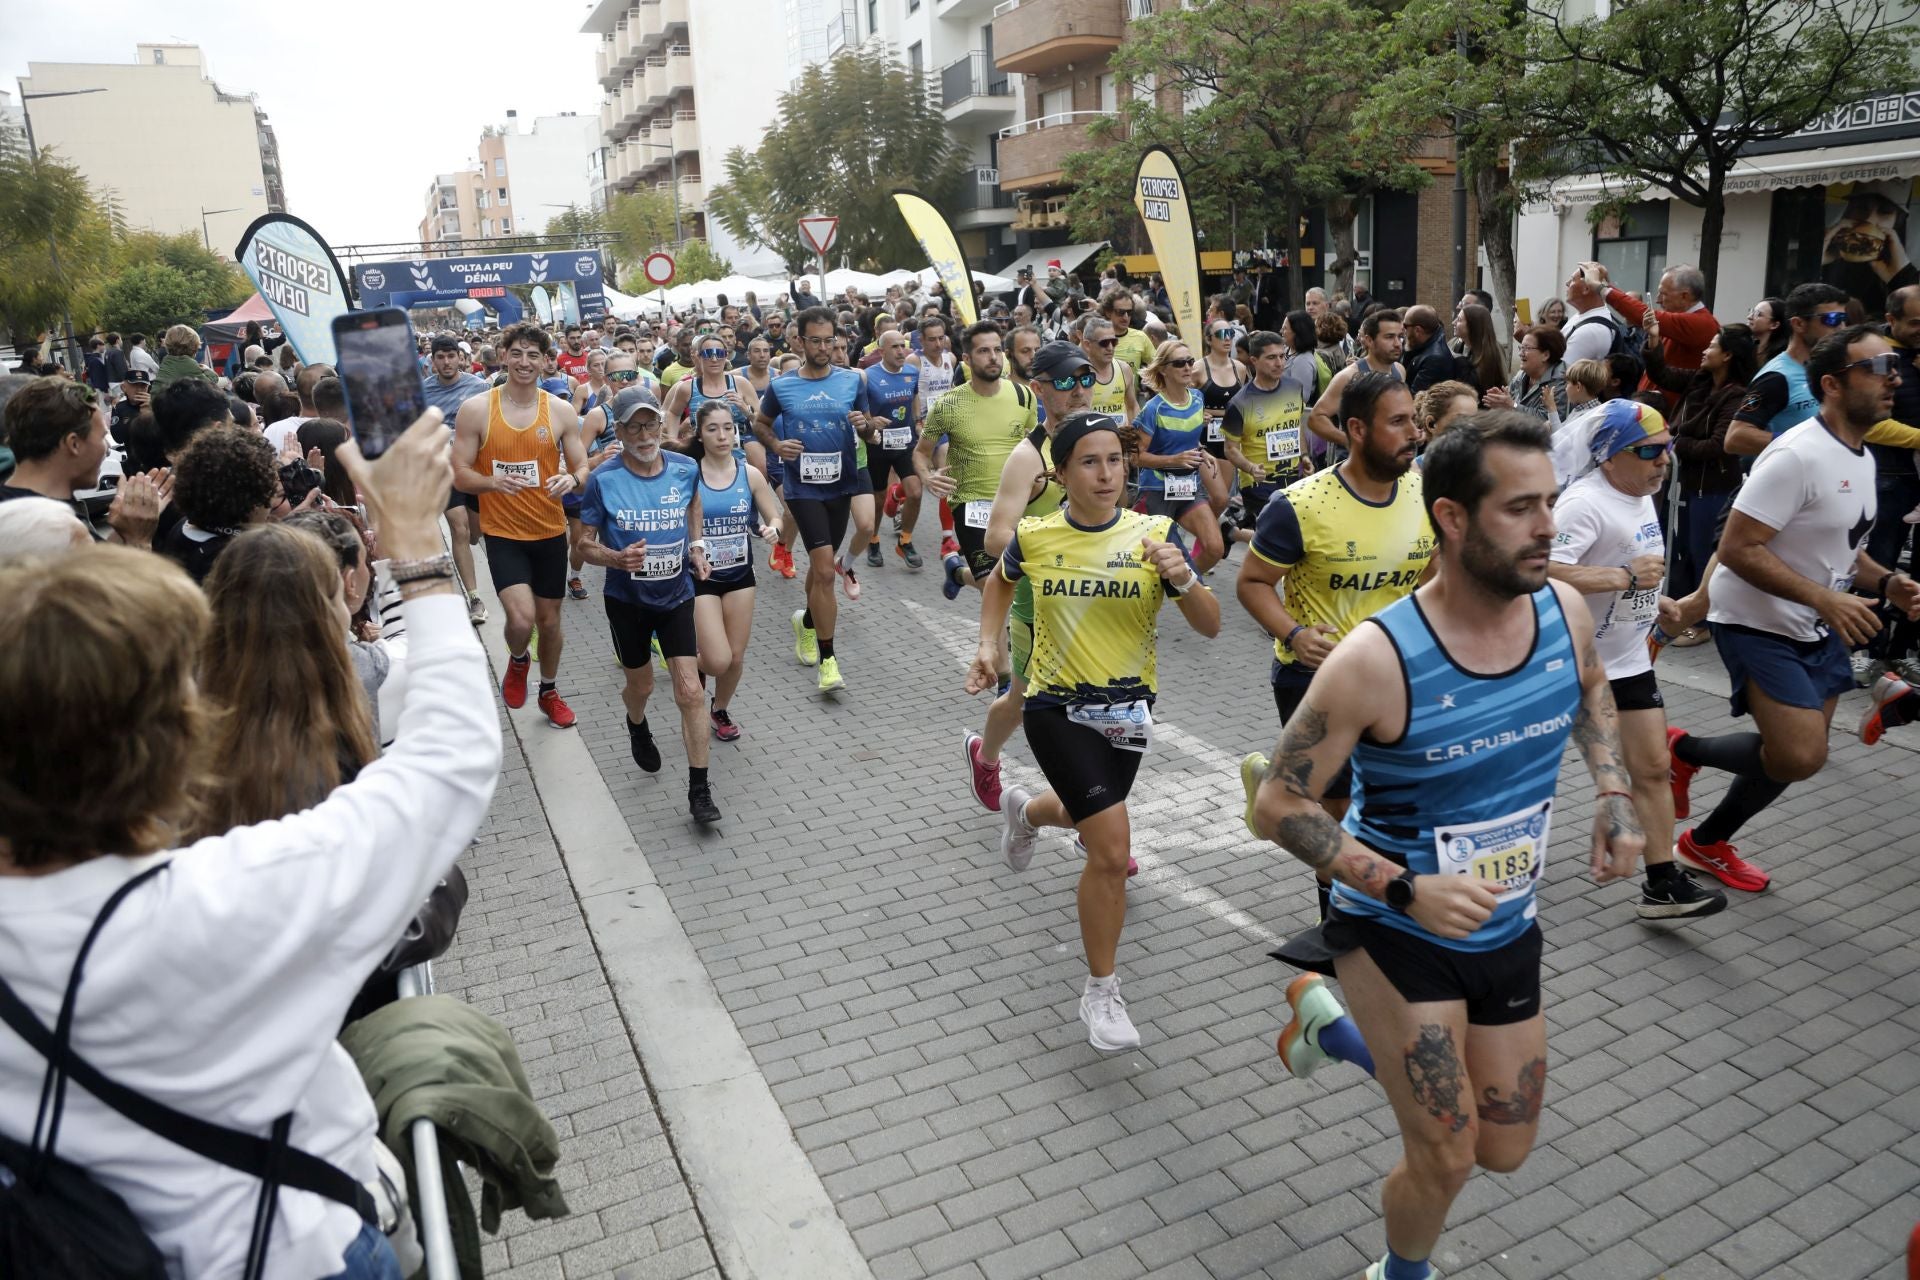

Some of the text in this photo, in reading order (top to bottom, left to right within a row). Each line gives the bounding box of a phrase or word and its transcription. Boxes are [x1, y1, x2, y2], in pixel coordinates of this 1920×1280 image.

[1770, 171, 1829, 186] PASTELERÍA
[1839, 165, 1898, 180] CAFETERÍA
[449, 262, 513, 273] VOLTA A PEU
[464, 272, 501, 284] DÉNIA
[814, 467, 830, 475] 911
[616, 507, 687, 521] ATLETISMO
[705, 553, 711, 561] P
[647, 560, 674, 571] 1413
[1632, 593, 1656, 610] 3590
[1491, 841, 1517, 853] CARLOS
[1478, 851, 1529, 880] 1183
